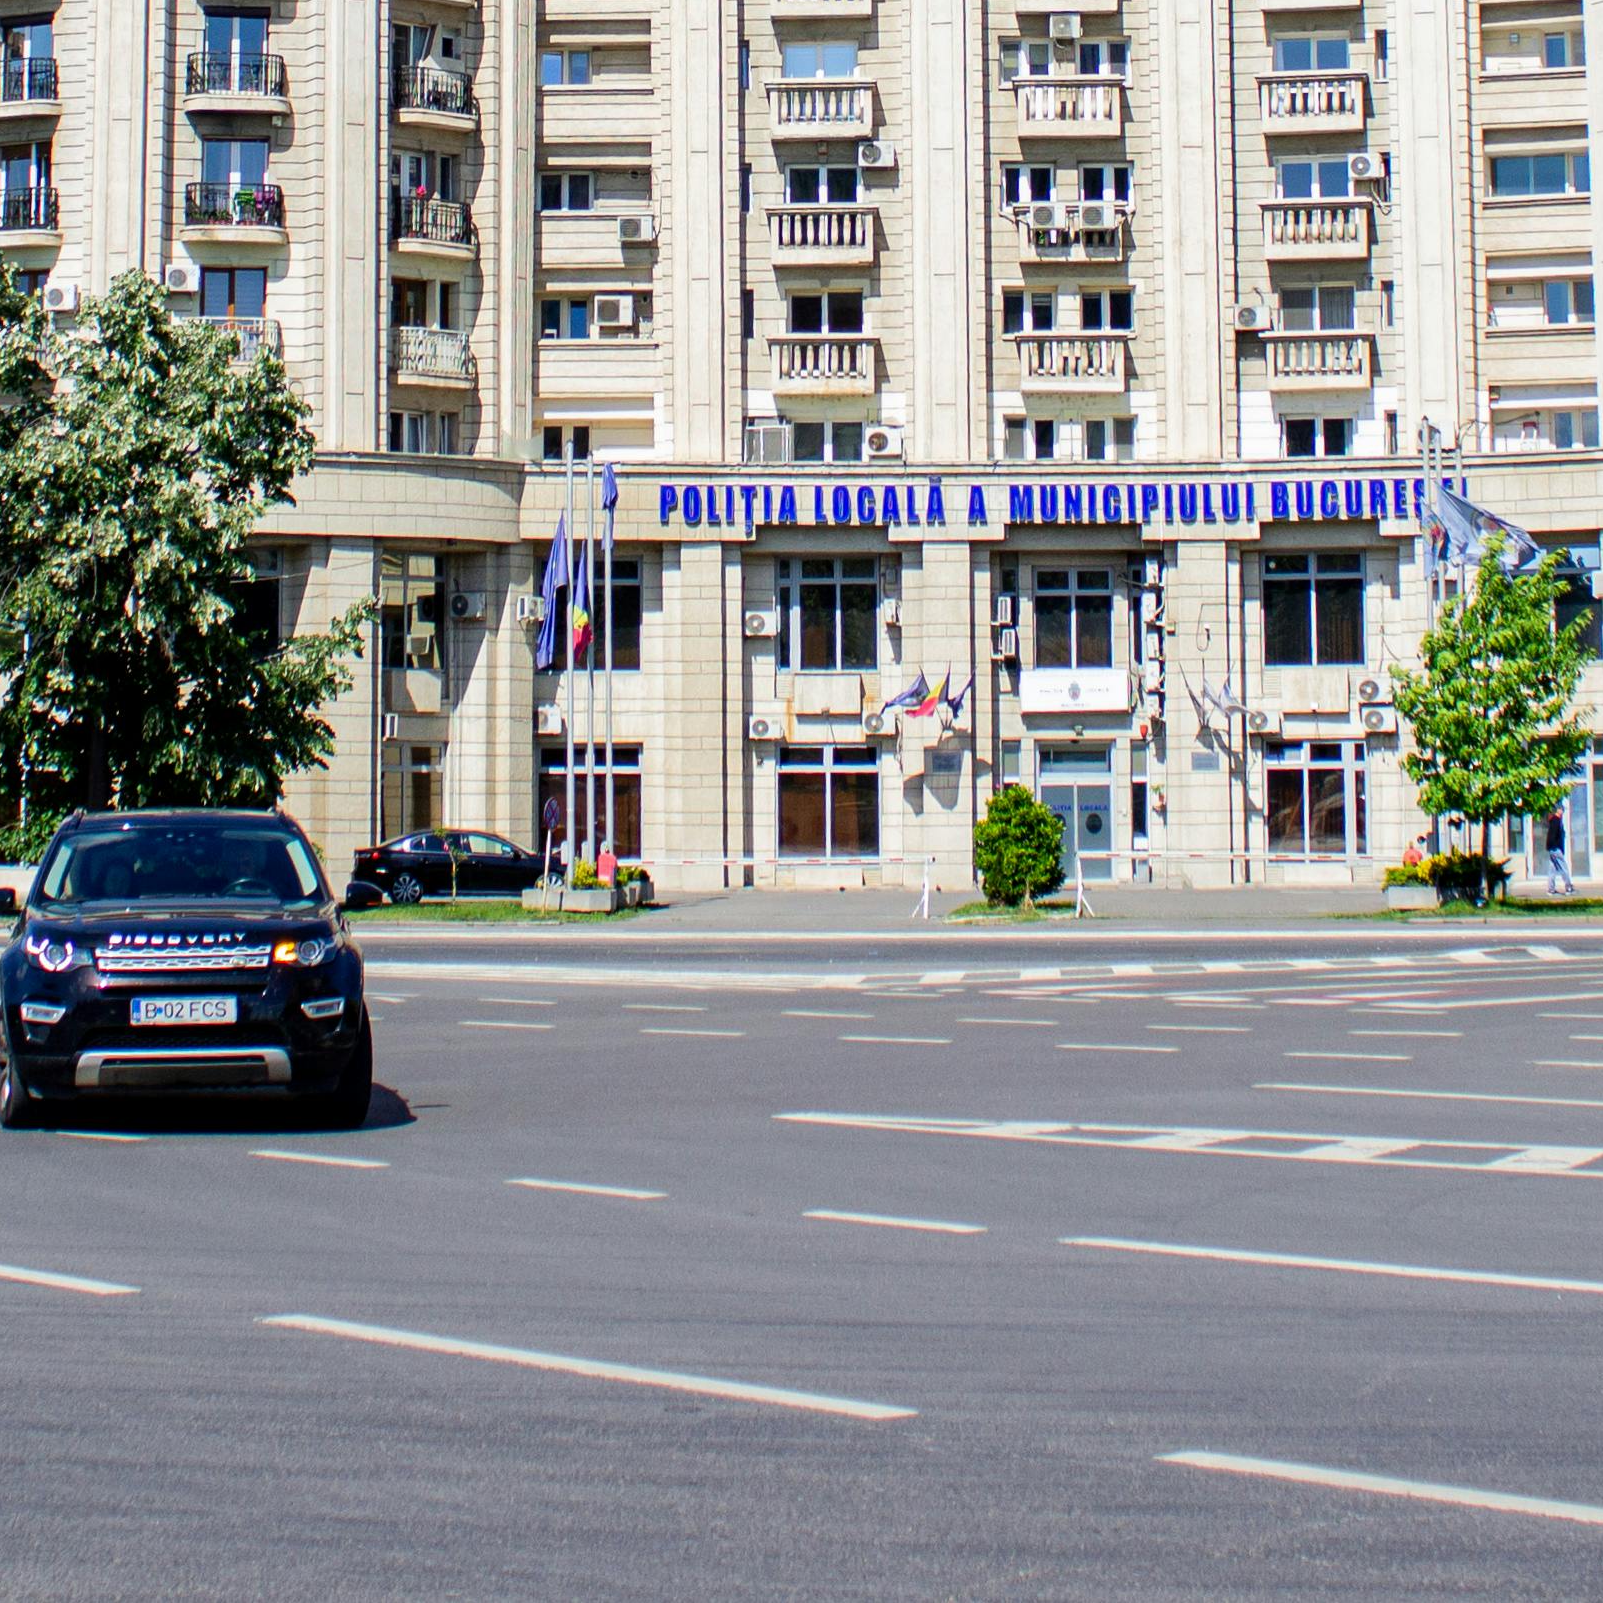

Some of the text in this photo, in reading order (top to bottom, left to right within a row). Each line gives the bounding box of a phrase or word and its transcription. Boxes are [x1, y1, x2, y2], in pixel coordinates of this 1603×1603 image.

[659, 484, 797, 539] POLIȚIA
[813, 476, 946, 526] LOCALĂ
[967, 484, 989, 526] A
[1009, 480, 1256, 524] MUNICIPIULUI
[109, 932, 246, 946] DISCOVERY
[163, 1002, 184, 1018] 02
[189, 1001, 227, 1018] FCS
